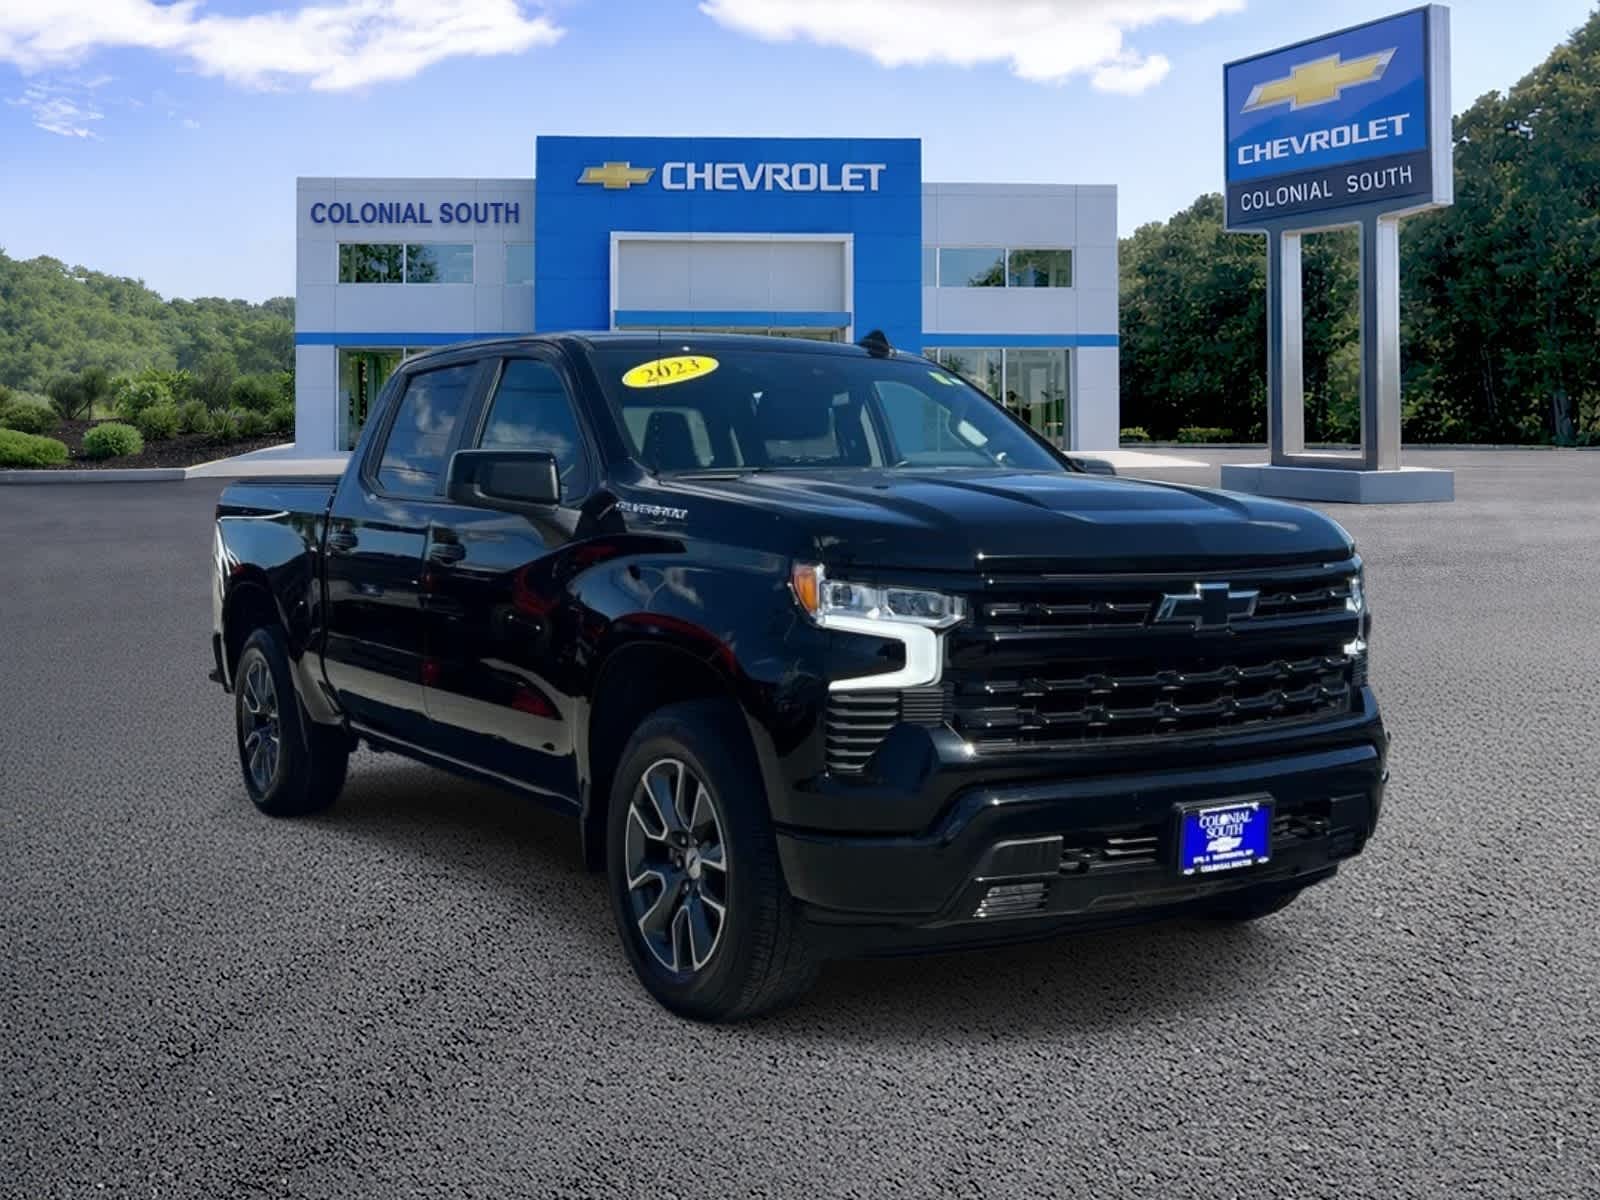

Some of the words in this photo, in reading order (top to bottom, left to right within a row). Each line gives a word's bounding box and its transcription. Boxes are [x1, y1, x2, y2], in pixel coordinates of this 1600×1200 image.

[1239, 114, 1410, 165] CHEVROLET
[662, 162, 886, 192] CHEVROLET
[1241, 180, 1333, 211] COLONIAL
[1347, 166, 1412, 192] SOUTH
[310, 203, 433, 223] COLONIAL
[439, 202, 520, 223] SOUTH
[642, 359, 700, 383] 2023
[1199, 810, 1252, 829] COLONIAL
[1206, 823, 1243, 839] SOUTH
